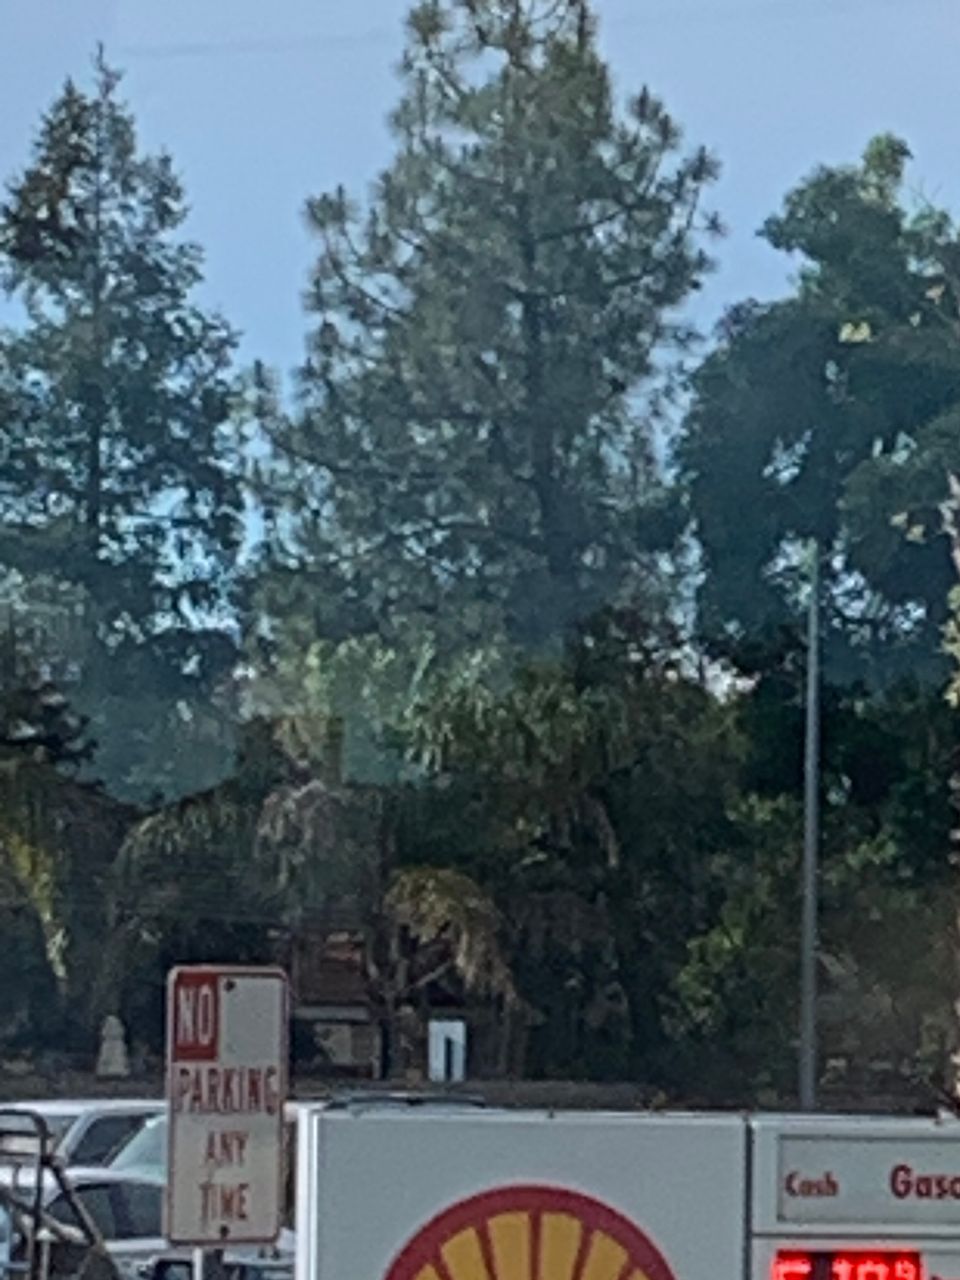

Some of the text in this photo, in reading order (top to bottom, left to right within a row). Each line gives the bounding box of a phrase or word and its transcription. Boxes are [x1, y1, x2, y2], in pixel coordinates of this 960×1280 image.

[176, 984, 216, 1046] NO
[174, 1066, 279, 1115] PARKING
[207, 1130, 248, 1164] ANY
[201, 1183, 248, 1224] TIME
[785, 1170, 839, 1197] Cash
